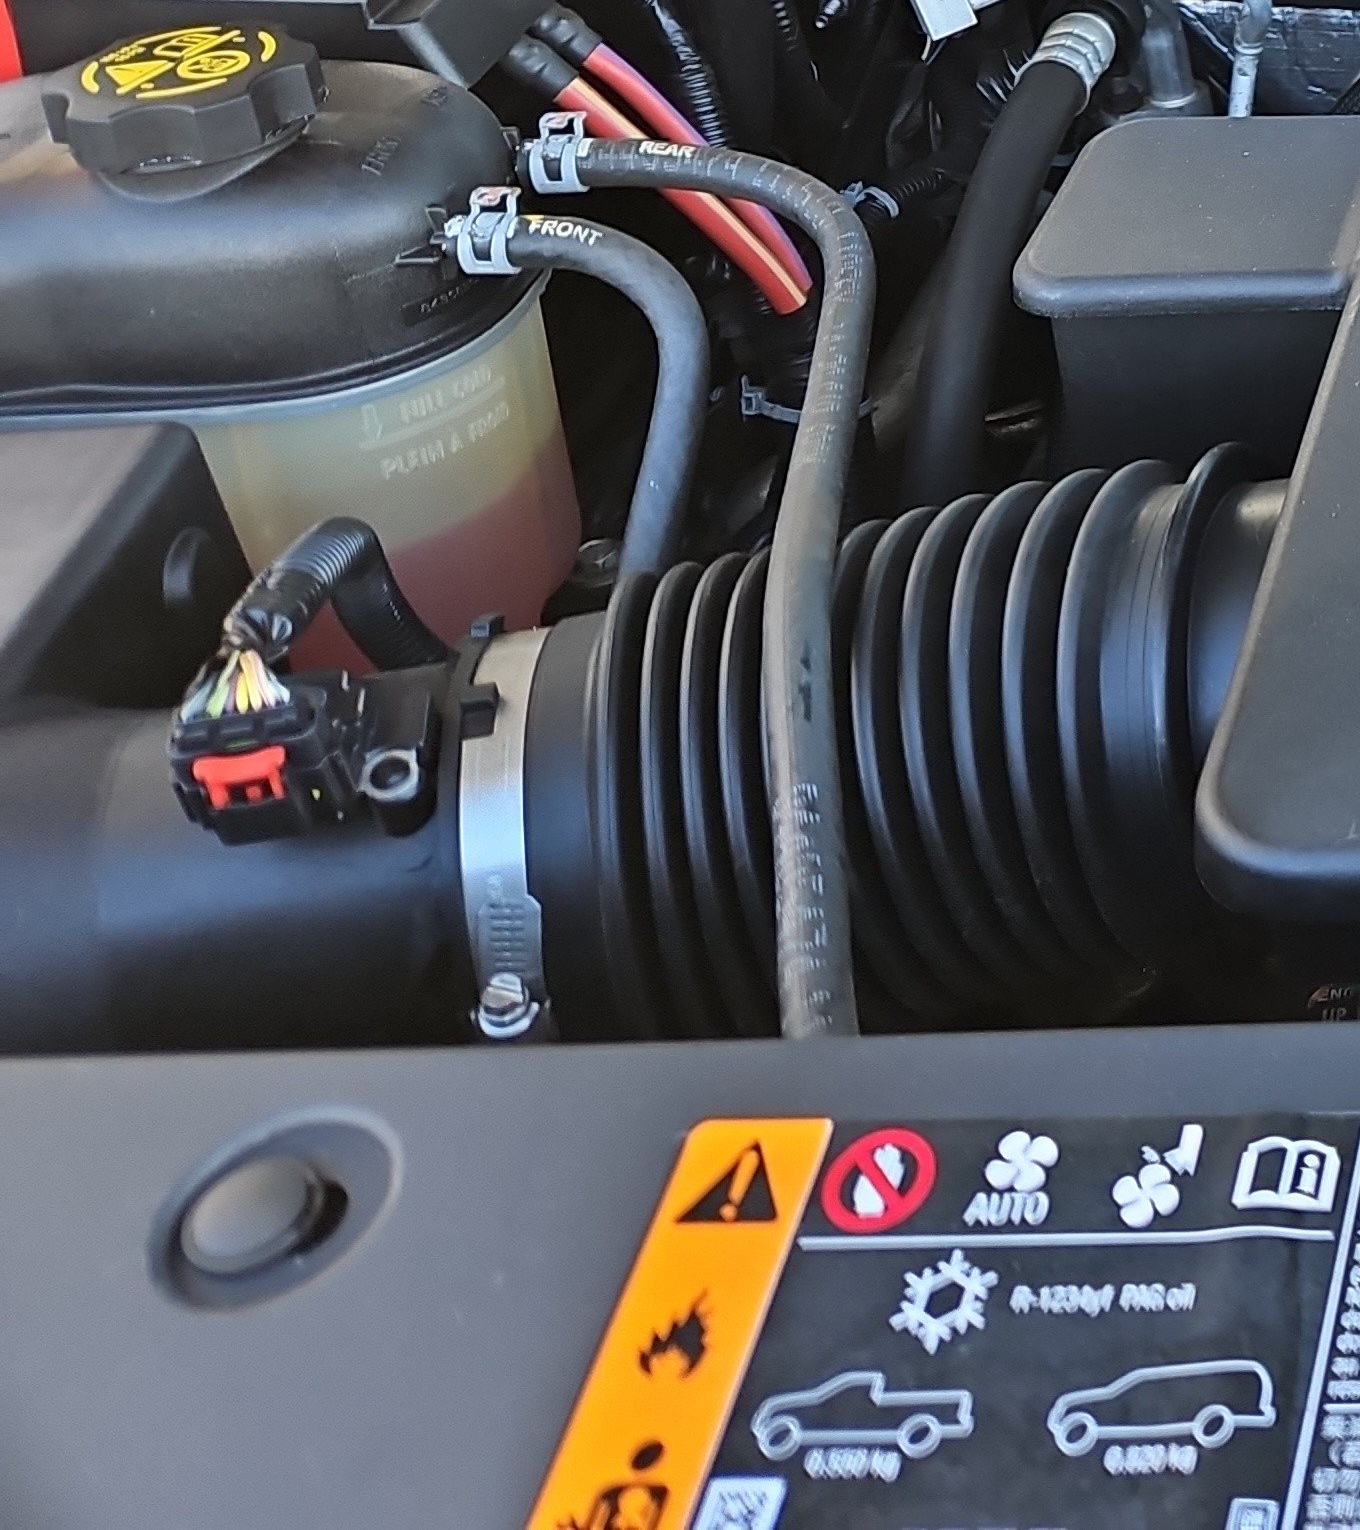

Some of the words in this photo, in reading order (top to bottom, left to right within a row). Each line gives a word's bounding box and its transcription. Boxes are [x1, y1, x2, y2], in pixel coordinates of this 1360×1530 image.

[638, 141, 696, 158] REAR
[528, 220, 603, 246] FRONT
[963, 1191, 1050, 1227] AUTO
